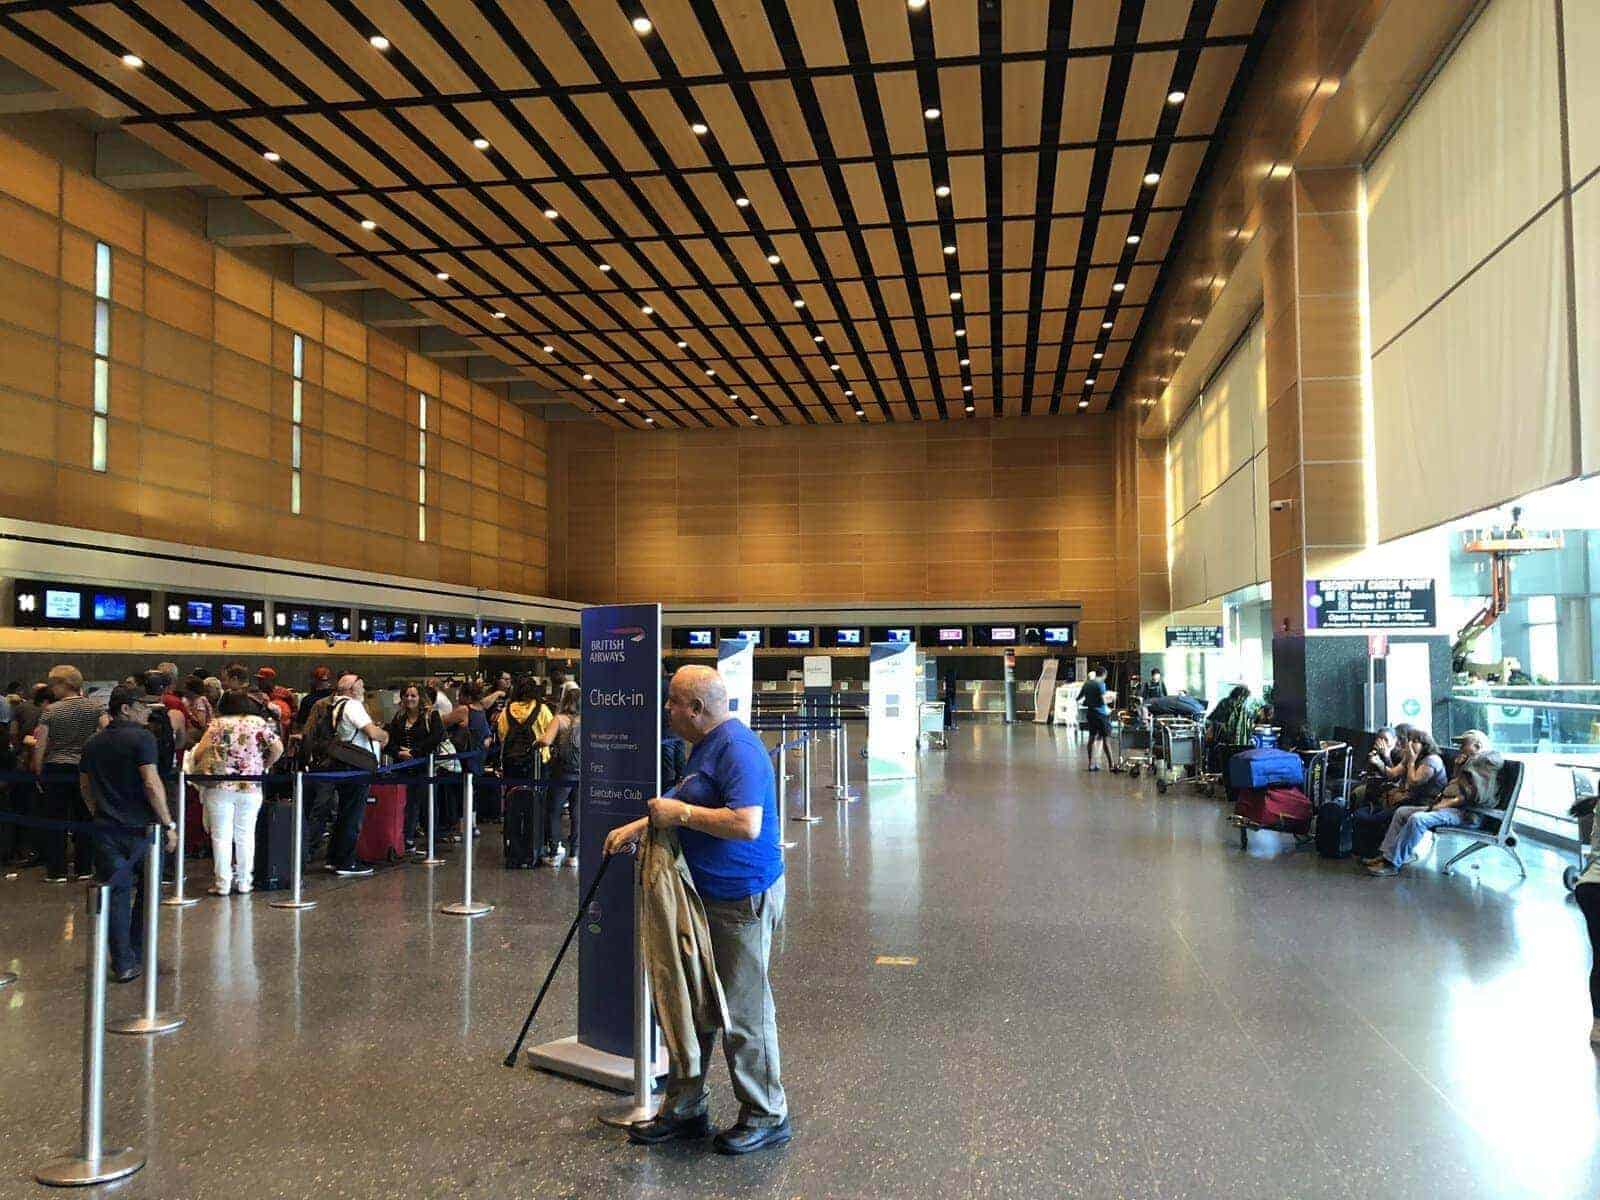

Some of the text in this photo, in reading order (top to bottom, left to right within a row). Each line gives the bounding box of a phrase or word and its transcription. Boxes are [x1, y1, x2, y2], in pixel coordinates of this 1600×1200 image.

[591, 639, 625, 651] BRITISH
[590, 651, 626, 664] AIRWAYS
[590, 688, 644, 707] Check-in
[590, 786, 642, 800] Executive Club
